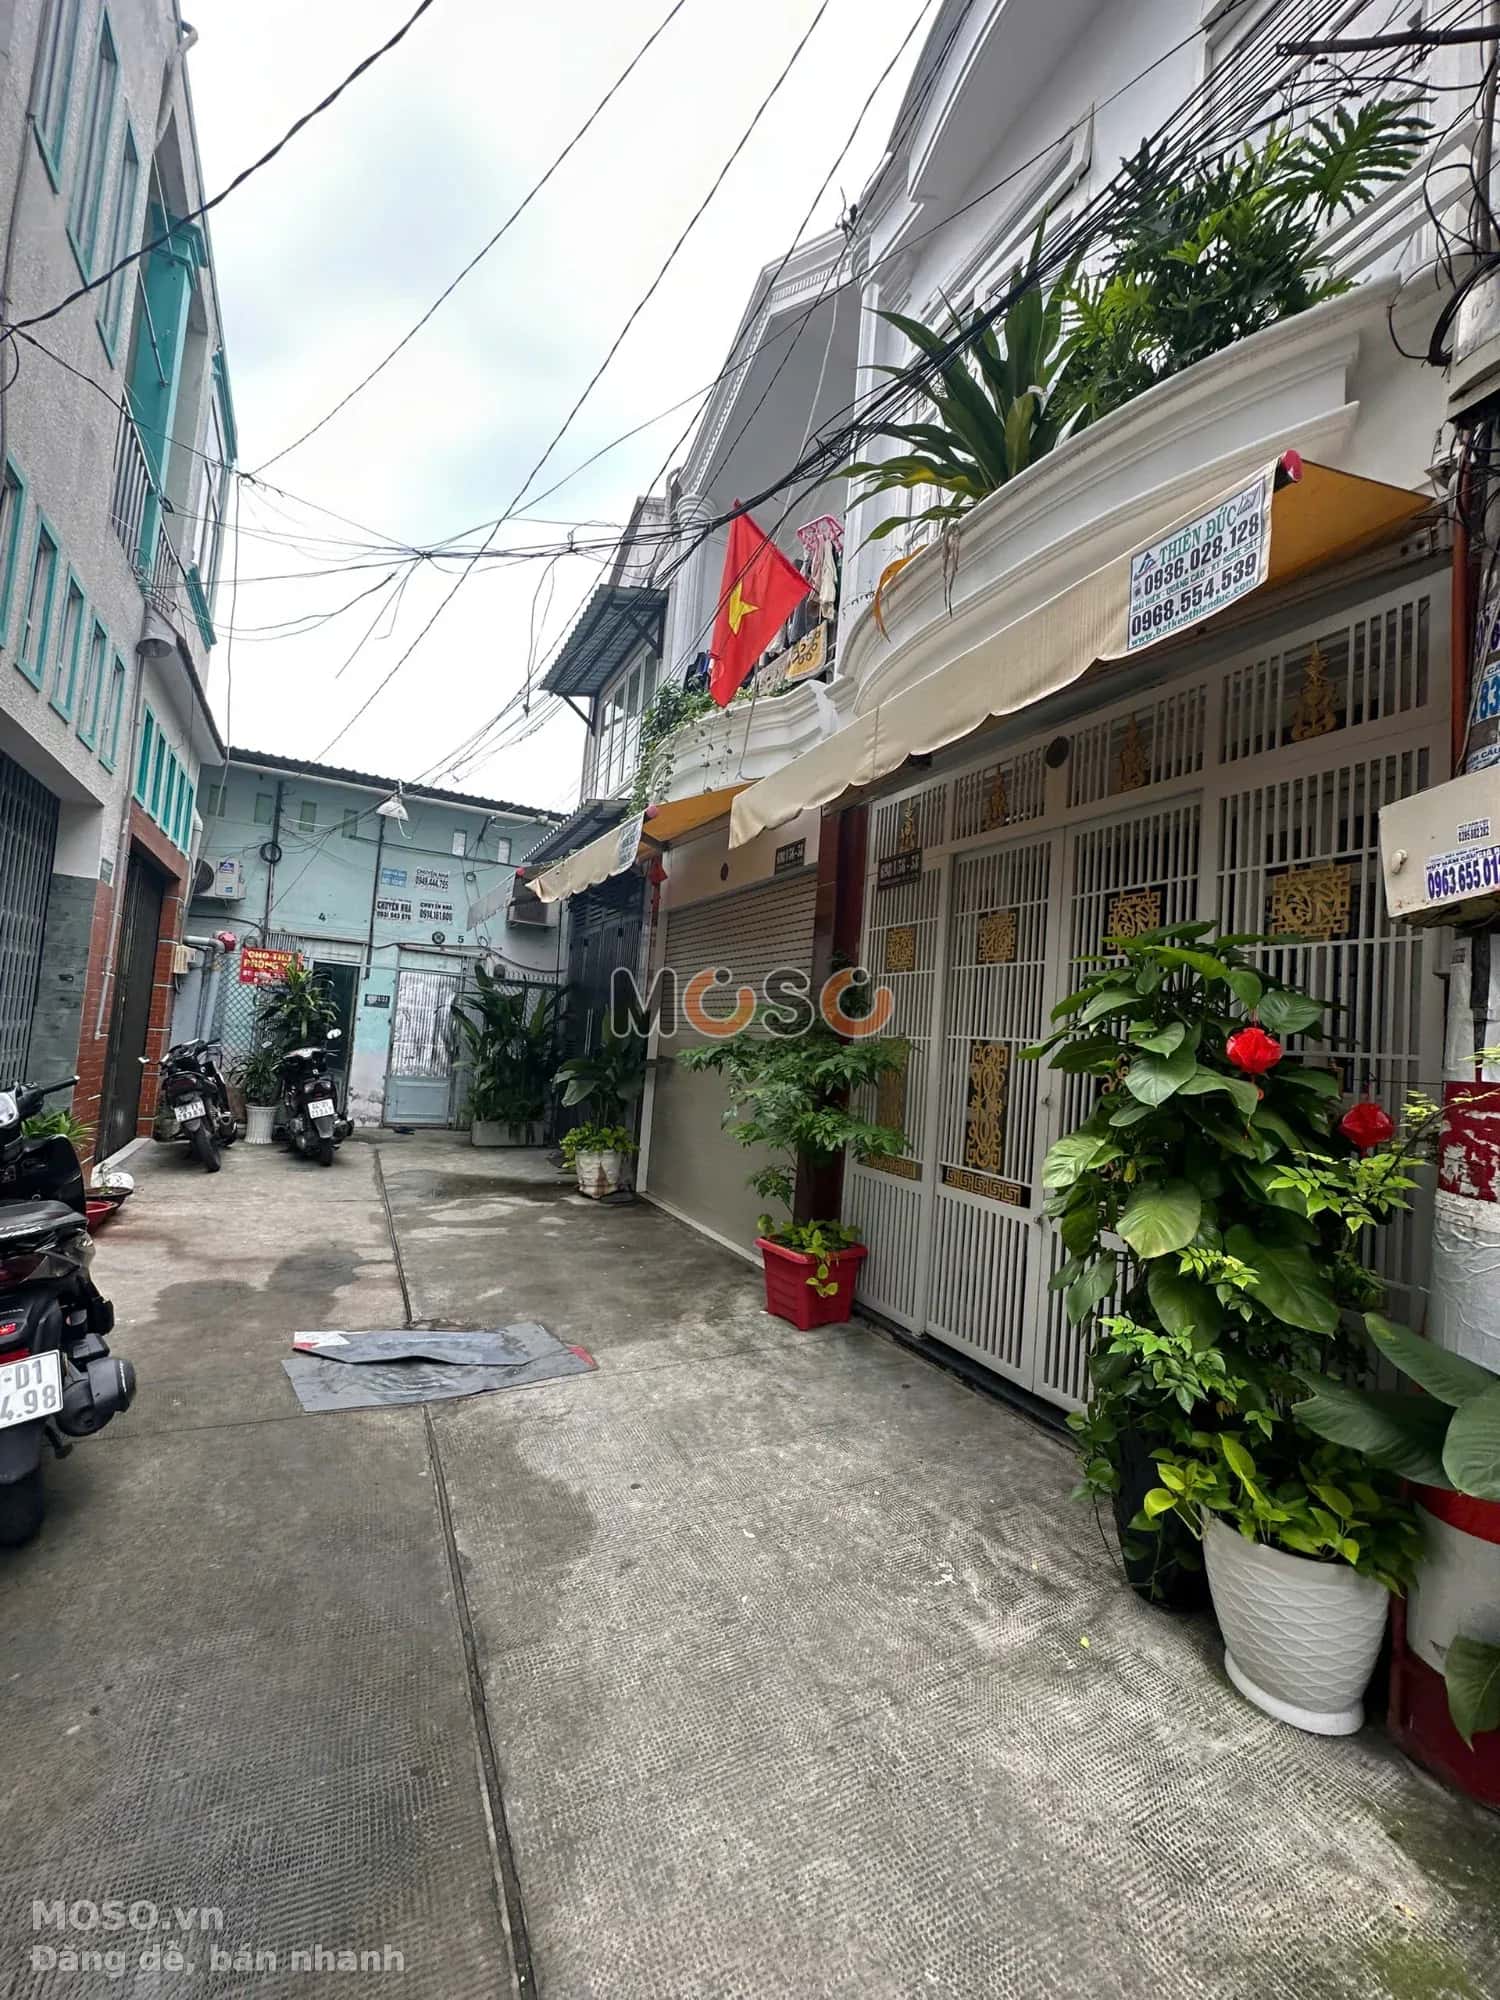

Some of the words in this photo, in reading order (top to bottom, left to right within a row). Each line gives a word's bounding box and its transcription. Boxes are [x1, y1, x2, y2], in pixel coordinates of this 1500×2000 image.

[1144, 512, 1259, 596] 0936.028.128
[1159, 525, 1202, 567] THIÊN
[1206, 505, 1237, 541] ĐỨC
[1131, 552, 1257, 636] 0968.554.539
[1428, 855, 1500, 899] 0963.655.01
[457, 935, 465, 943] 5
